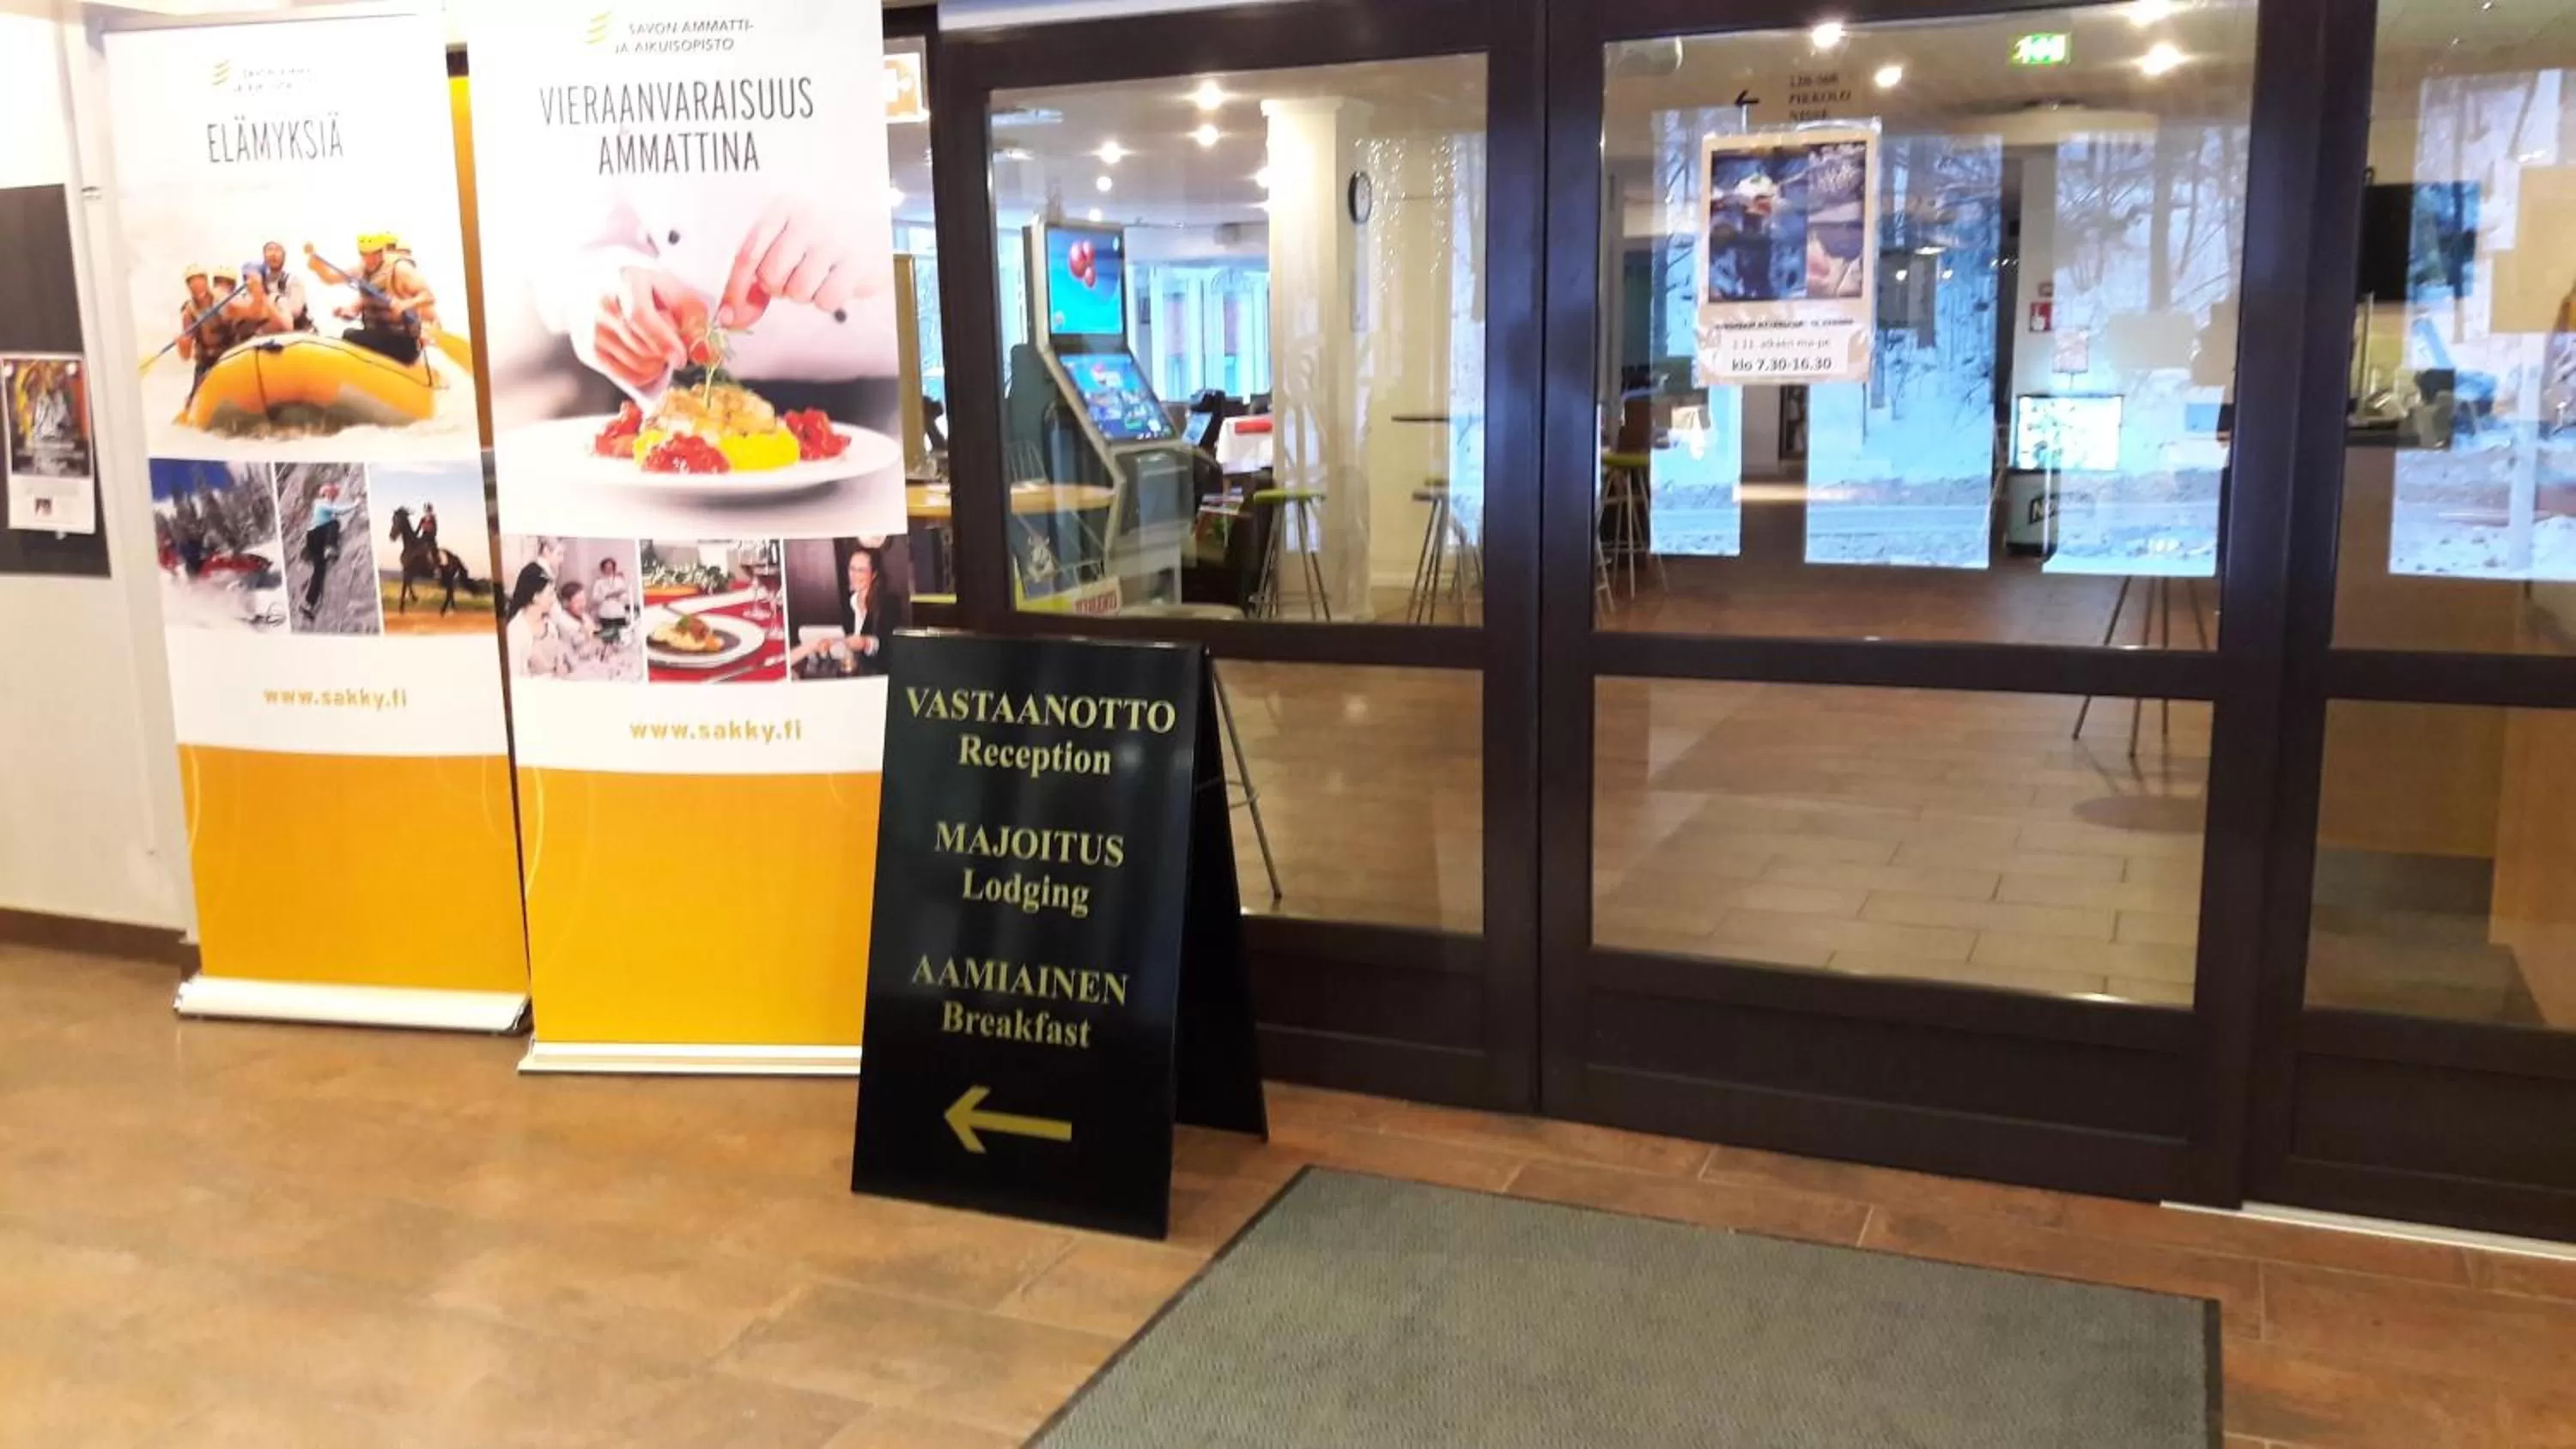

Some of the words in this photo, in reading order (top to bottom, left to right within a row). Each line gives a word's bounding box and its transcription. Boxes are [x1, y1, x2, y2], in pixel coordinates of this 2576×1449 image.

[614, 42, 628, 54] JA
[635, 38, 735, 53] AIKUISOPISTO
[629, 21, 677, 35] SAVON
[682, 18, 754, 33] AMMATTI-
[539, 76, 814, 126] VIERAANVARAISUUS
[207, 110, 343, 162] ELÄMYKSIÄ
[598, 130, 760, 176] AMMATTINA
[1732, 357, 1753, 372] klo
[263, 687, 408, 712] www.sakky.fi
[906, 687, 1176, 733] VASTAANOTTO
[629, 718, 803, 745] www.sakky.fi
[959, 735, 1112, 778] Reception
[935, 822, 1125, 868] MAJOITUS
[963, 870, 1090, 918] Lodging
[911, 955, 1129, 1006] AAMIAINEN
[942, 1001, 1091, 1049] Breakfast
